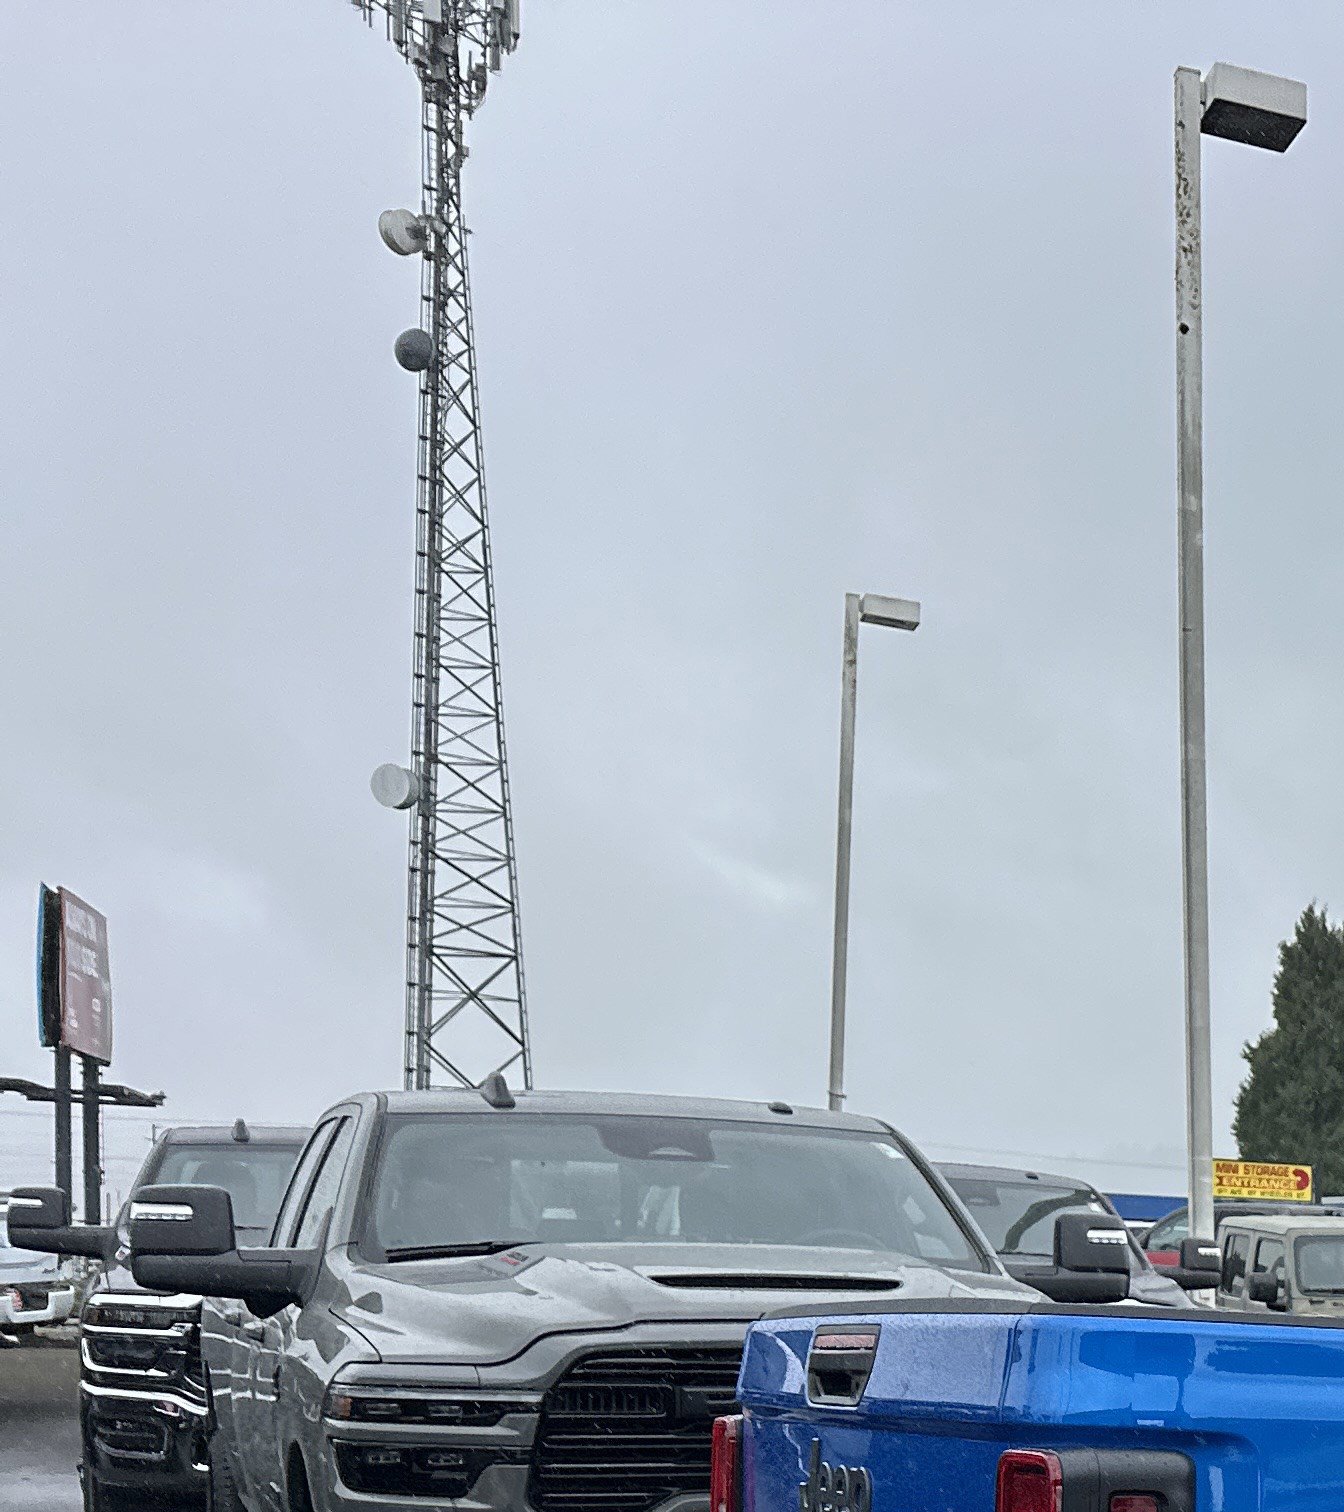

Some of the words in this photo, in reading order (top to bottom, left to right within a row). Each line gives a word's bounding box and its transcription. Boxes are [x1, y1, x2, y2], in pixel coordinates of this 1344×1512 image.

[1215, 1162, 1239, 1174] MINI
[1243, 1164, 1289, 1177] STORAGE
[1222, 1175, 1297, 1190] ENTRANCE
